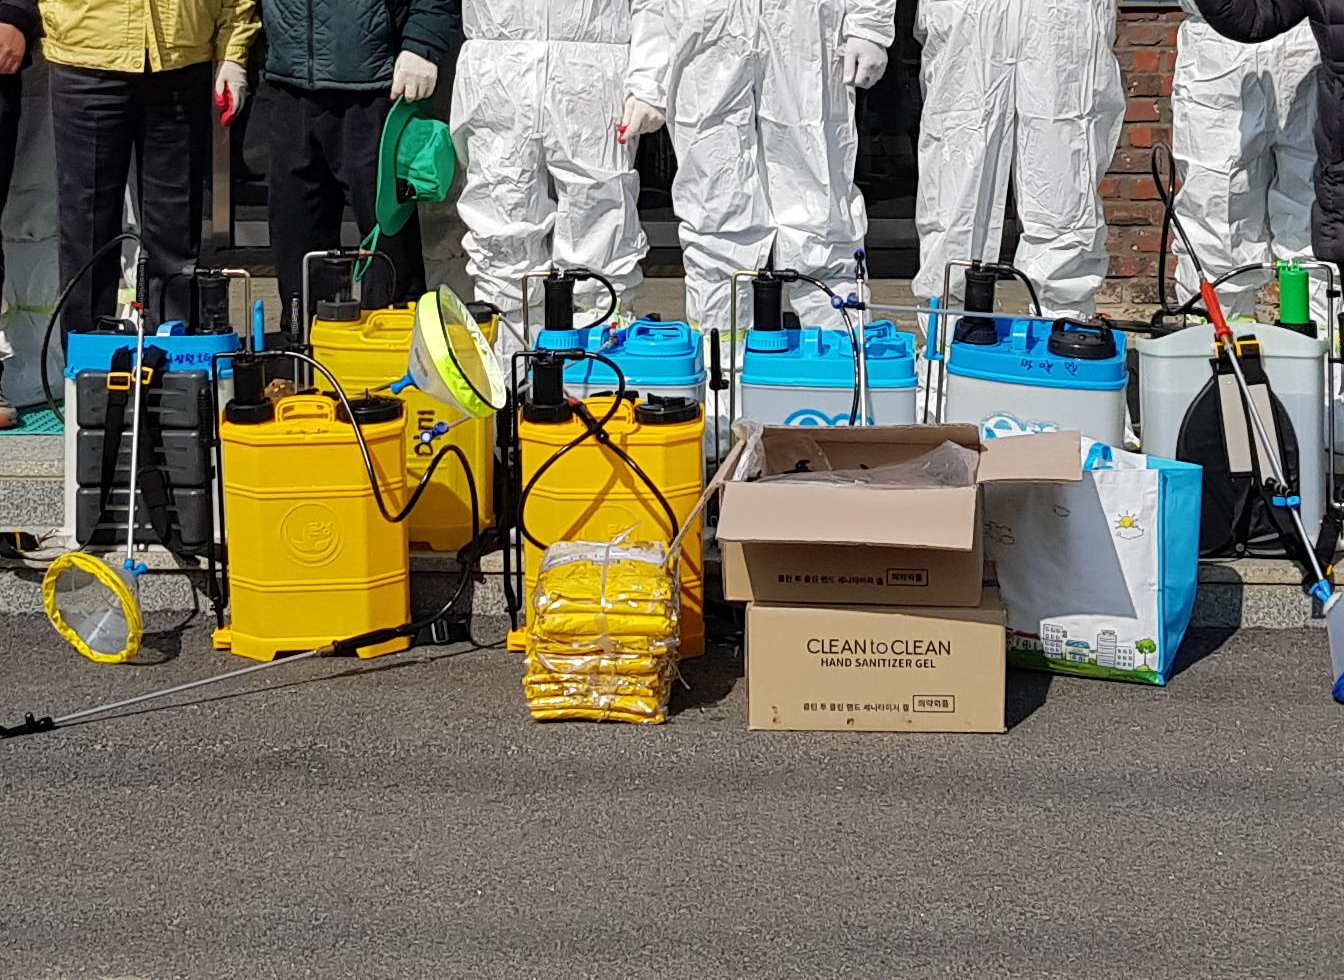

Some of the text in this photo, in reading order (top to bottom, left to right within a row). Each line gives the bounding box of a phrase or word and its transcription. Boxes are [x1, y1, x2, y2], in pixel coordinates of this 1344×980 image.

[807, 638, 951, 656] CLEAN to CLEAN
[821, 657, 937, 669] HAND SANITIZER GEL
